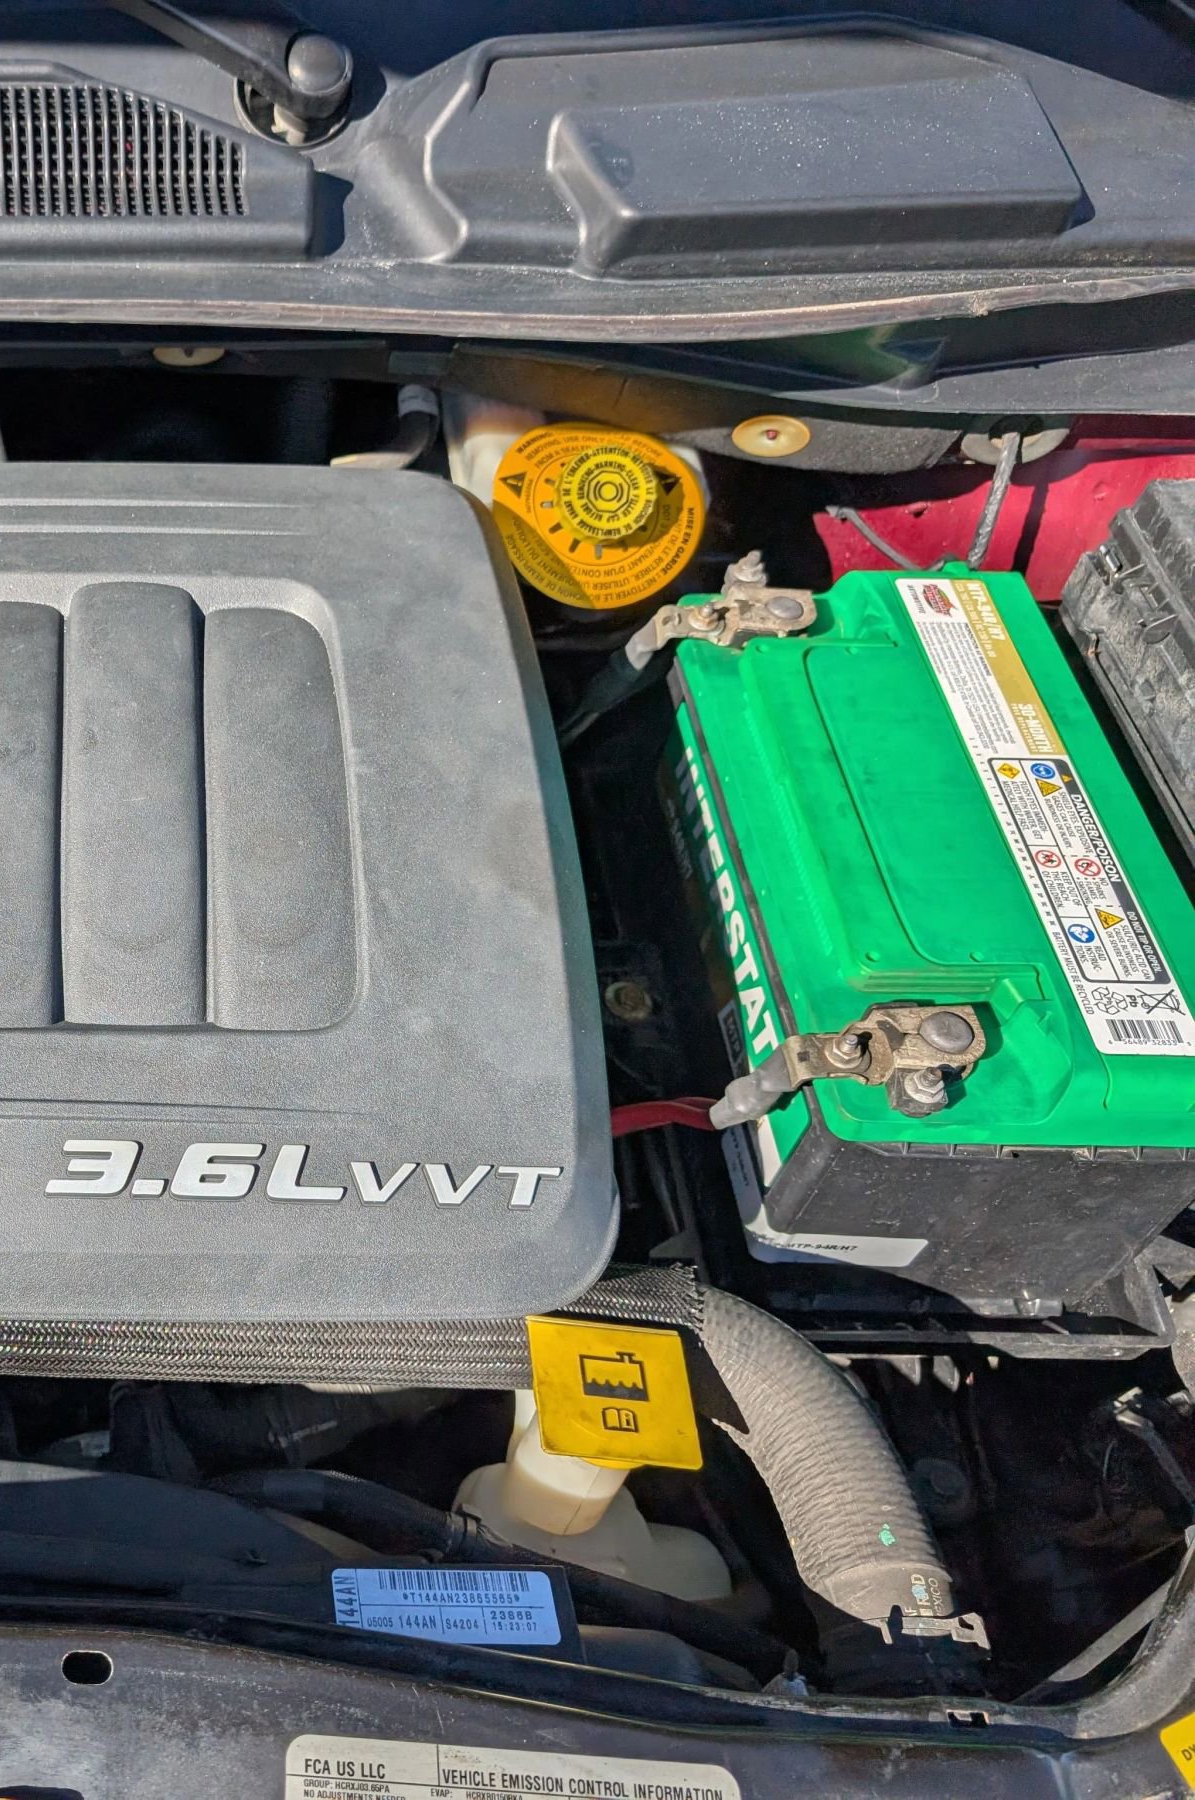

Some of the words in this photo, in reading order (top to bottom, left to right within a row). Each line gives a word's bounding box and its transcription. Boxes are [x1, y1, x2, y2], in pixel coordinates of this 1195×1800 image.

[687, 507, 695, 529] MISE
[682, 532, 691, 545] EN
[604, 566, 625, 577] D'UN
[593, 578, 630, 591] UTILISER
[615, 576, 658, 600] NETTOYER
[604, 592, 615, 601] LE
[1070, 794, 1121, 881] DANGER/POISON
[1050, 871, 1062, 881] THE
[1055, 882, 1071, 901] REACH
[1059, 871, 1073, 885] KEEP
[1066, 886, 1078, 898] OUT
[676, 746, 780, 1057] INTERSTAT
[1126, 911, 1138, 920] DO
[1130, 921, 1144, 932] NOT
[1051, 932, 1070, 956] BATTERY
[1136, 935, 1149, 944] TIP
[1092, 945, 1106, 960] READ
[1108, 939, 1123, 957] SEVERE
[1112, 927, 1126, 943] CAUSE
[1120, 945, 1139, 972] BLINDNESS
[1119, 924, 1139, 952] SULFURIC
[1133, 953, 1146, 967] ACID
[1140, 969, 1152, 979] CAN
[1141, 945, 1153, 953] OR
[1062, 957, 1078, 974] MUST
[1070, 975, 1082, 983] BE
[1074, 984, 1095, 1014] RECYCLED
[1125, 994, 1140, 1007] Pb
[928, 1577, 942, 1616] EXICO
[398, 1615, 437, 1628] 144AN
[445, 1618, 479, 1630] S4204
[490, 1610, 533, 1621] 2386B
[493, 1622, 538, 1632] 15:23:07
[304, 1758, 331, 1775] FCA
[336, 1760, 355, 1777] US
[360, 1762, 386, 1779] LLC
[304, 1779, 333, 1789] GROUP:
[442, 1769, 496, 1788] VEHICLE
[501, 1773, 564, 1793] EMISSION
[568, 1778, 630, 1798] CONTROL
[633, 1783, 723, 1800] INFORMATION
[304, 1789, 315, 1798] NO
[317, 1790, 373, 1800] ADJUSTMENTS
[430, 1788, 453, 1798] EVAP:
